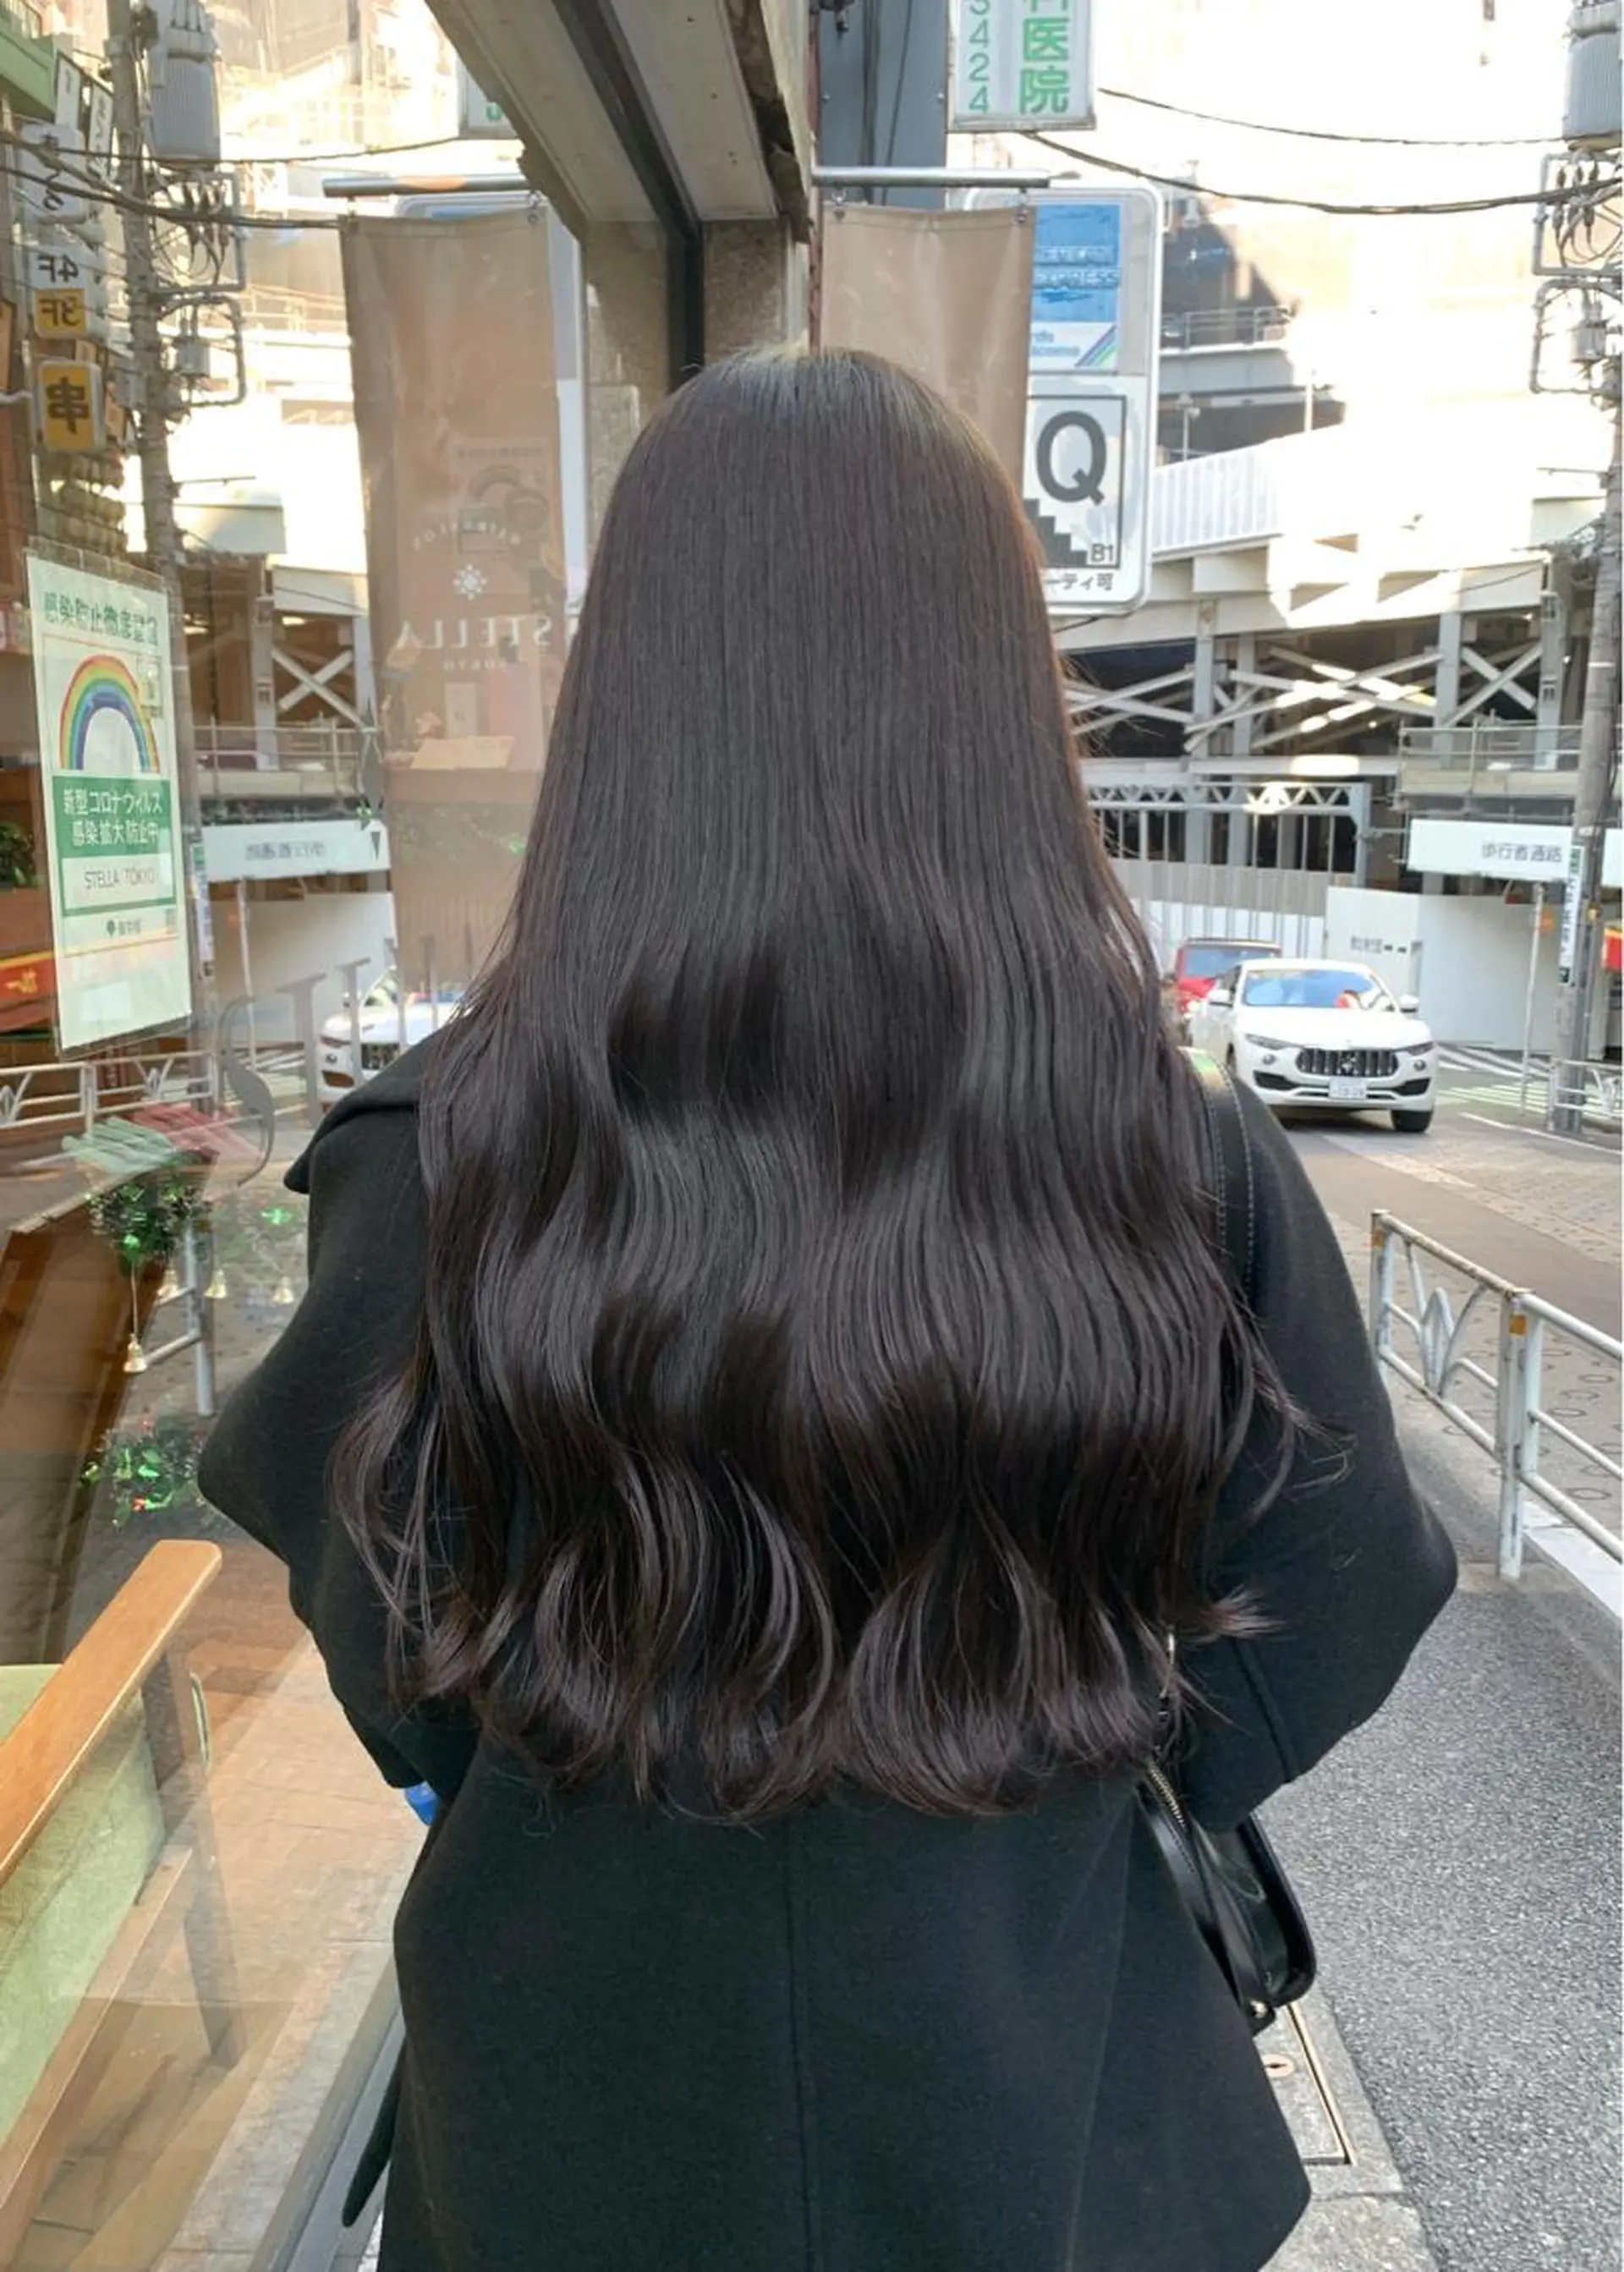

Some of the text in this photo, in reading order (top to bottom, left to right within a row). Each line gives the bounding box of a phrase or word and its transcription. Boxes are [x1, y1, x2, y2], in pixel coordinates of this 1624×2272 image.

[1019, 0, 1070, 114] 医院
[1036, 409, 1106, 506] Q
[1091, 543, 1114, 563] B1
[84, 869, 119, 890] STELLA
